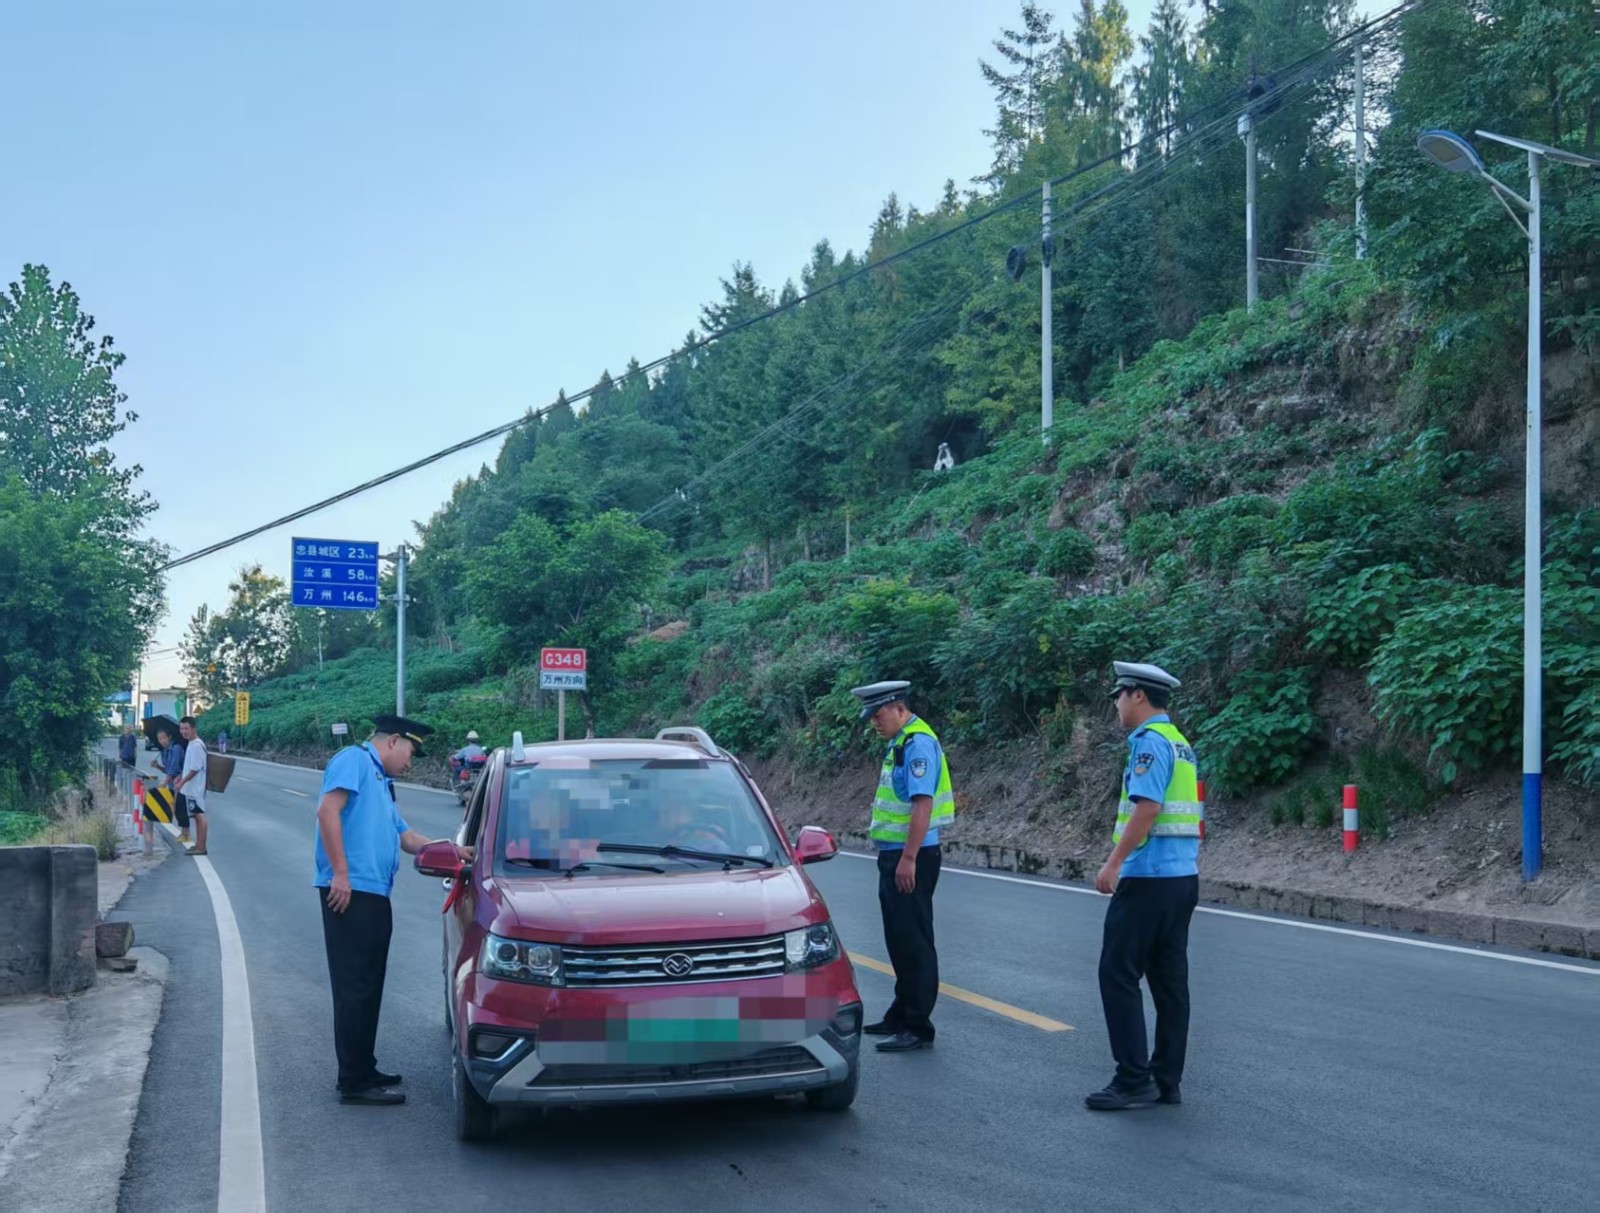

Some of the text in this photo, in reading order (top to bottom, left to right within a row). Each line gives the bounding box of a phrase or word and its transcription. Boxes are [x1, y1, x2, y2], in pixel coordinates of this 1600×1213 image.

[296, 545, 340, 558] 忠县城区
[303, 589, 332, 601] 万州
[546, 653, 581, 666] G348
[543, 674, 583, 685] 万州方向
